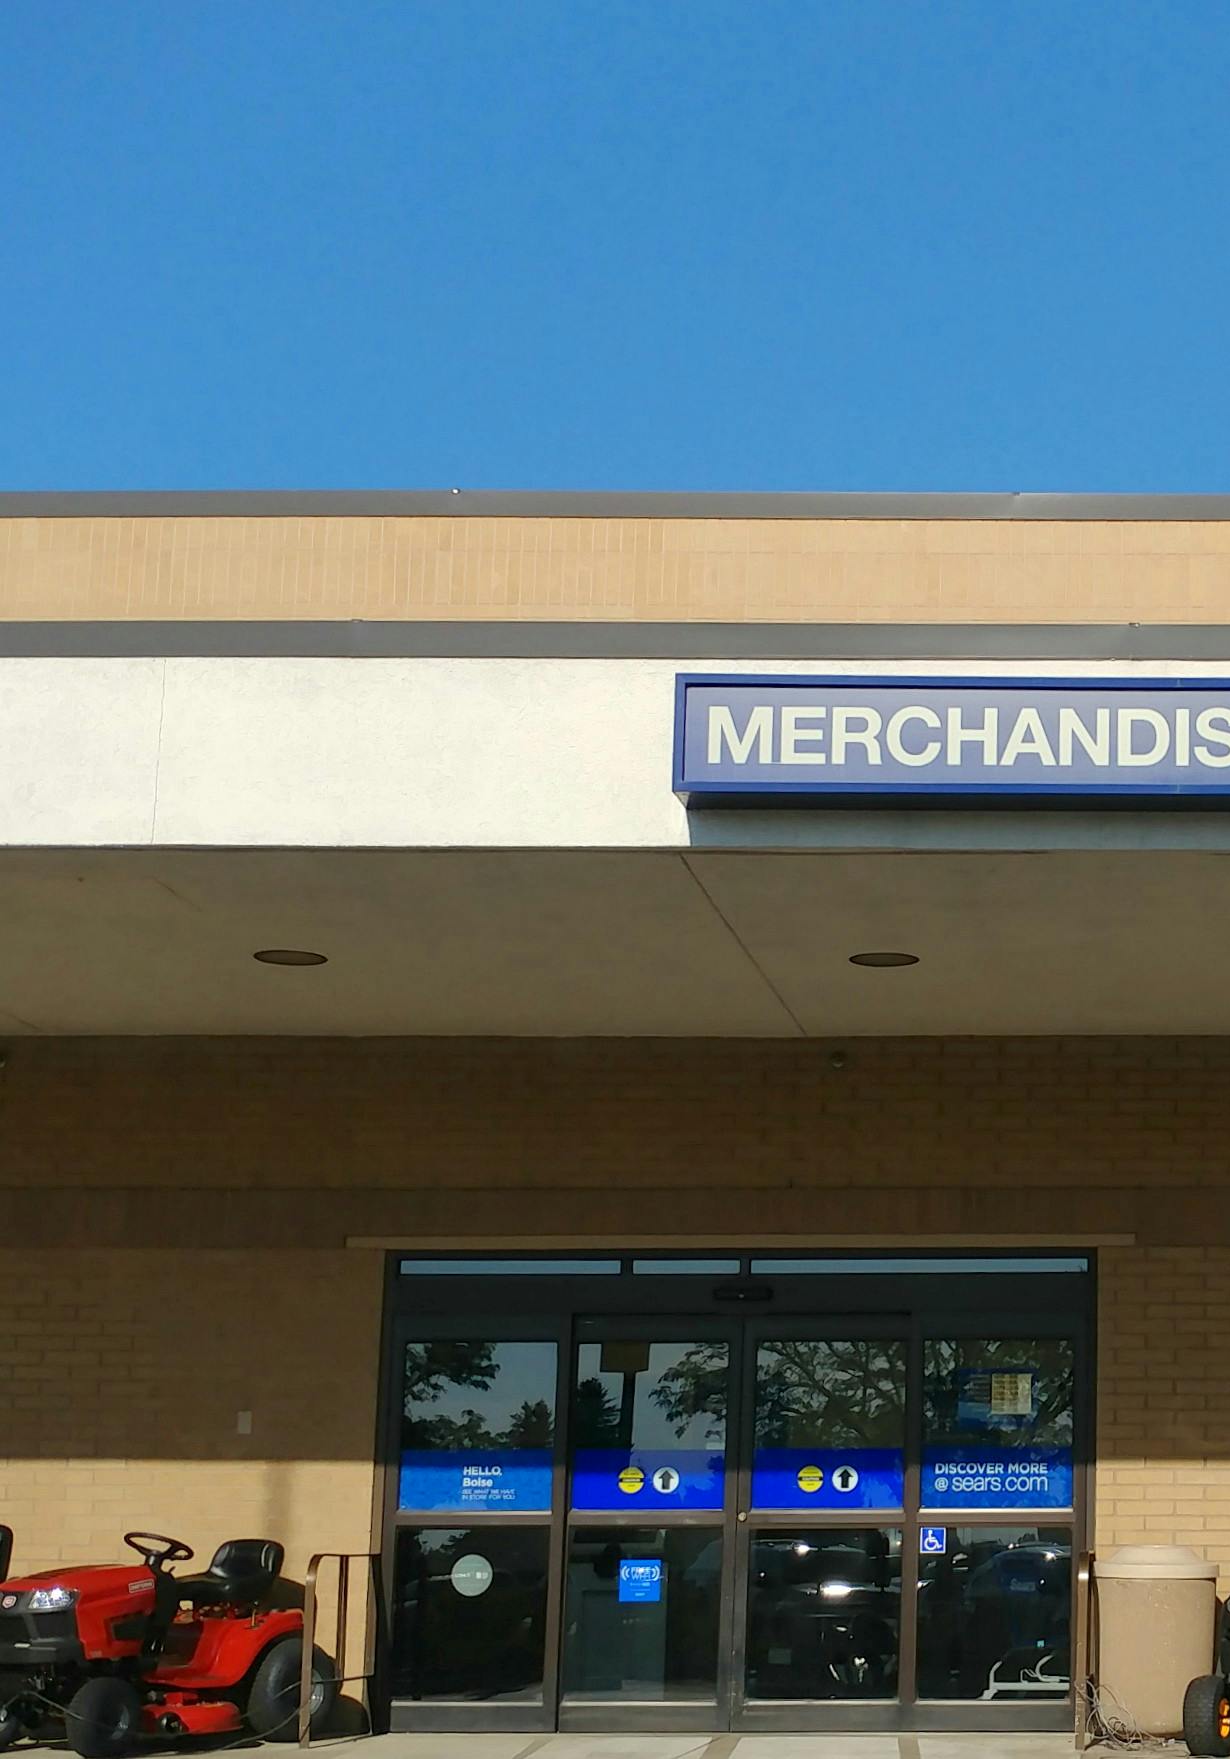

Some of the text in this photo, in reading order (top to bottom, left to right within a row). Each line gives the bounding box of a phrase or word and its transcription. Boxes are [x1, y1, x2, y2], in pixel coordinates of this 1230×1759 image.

[935, 1463, 1048, 1474] DISCOVER MORE
[463, 1477, 493, 1487] Boise
[935, 1476, 1048, 1492] @ sears.com
